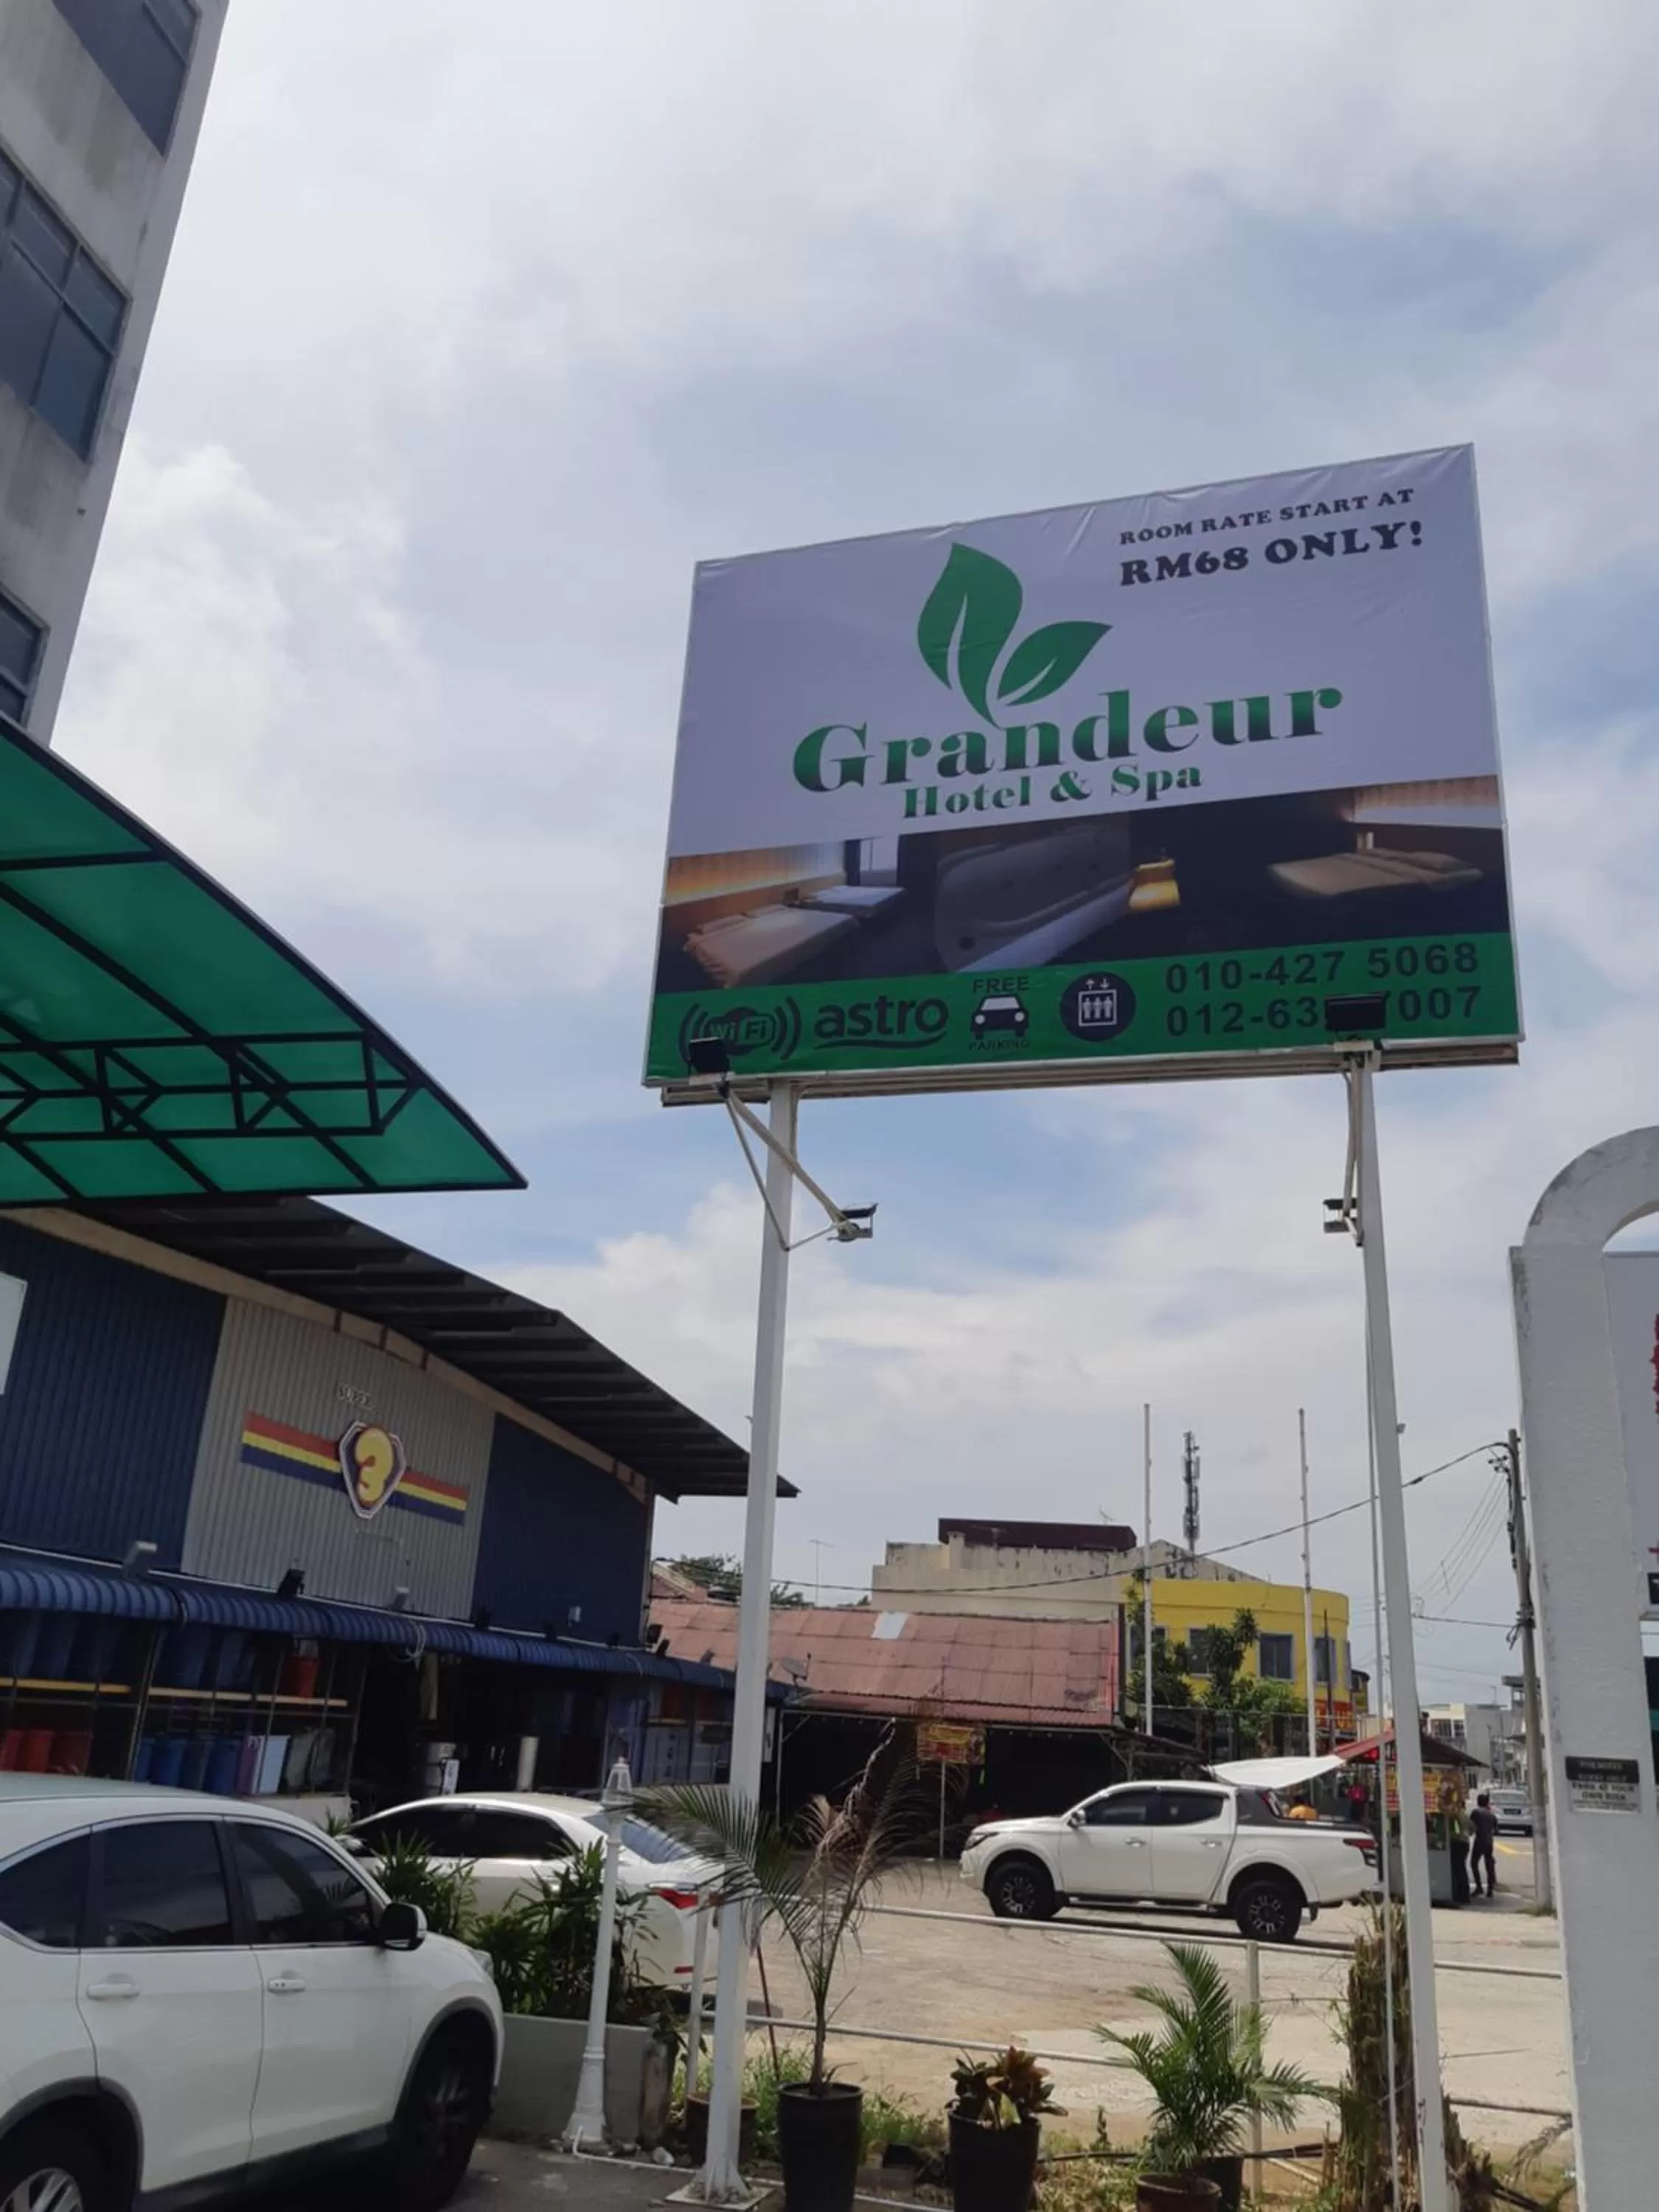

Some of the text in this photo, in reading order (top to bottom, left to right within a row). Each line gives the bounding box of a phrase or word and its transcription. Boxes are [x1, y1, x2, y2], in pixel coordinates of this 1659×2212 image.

[1119, 489, 1413, 545] ROOM RATE START AT
[1120, 520, 1422, 587] RM68 ONLY!
[793, 687, 1342, 793] Grandeur
[902, 764, 1203, 818] Hotel & Spa
[973, 975, 1029, 994] FREE
[1166, 942, 1478, 993] 010-427 5068
[813, 995, 948, 1039] astro
[1166, 986, 1481, 1036] 012-63 007
